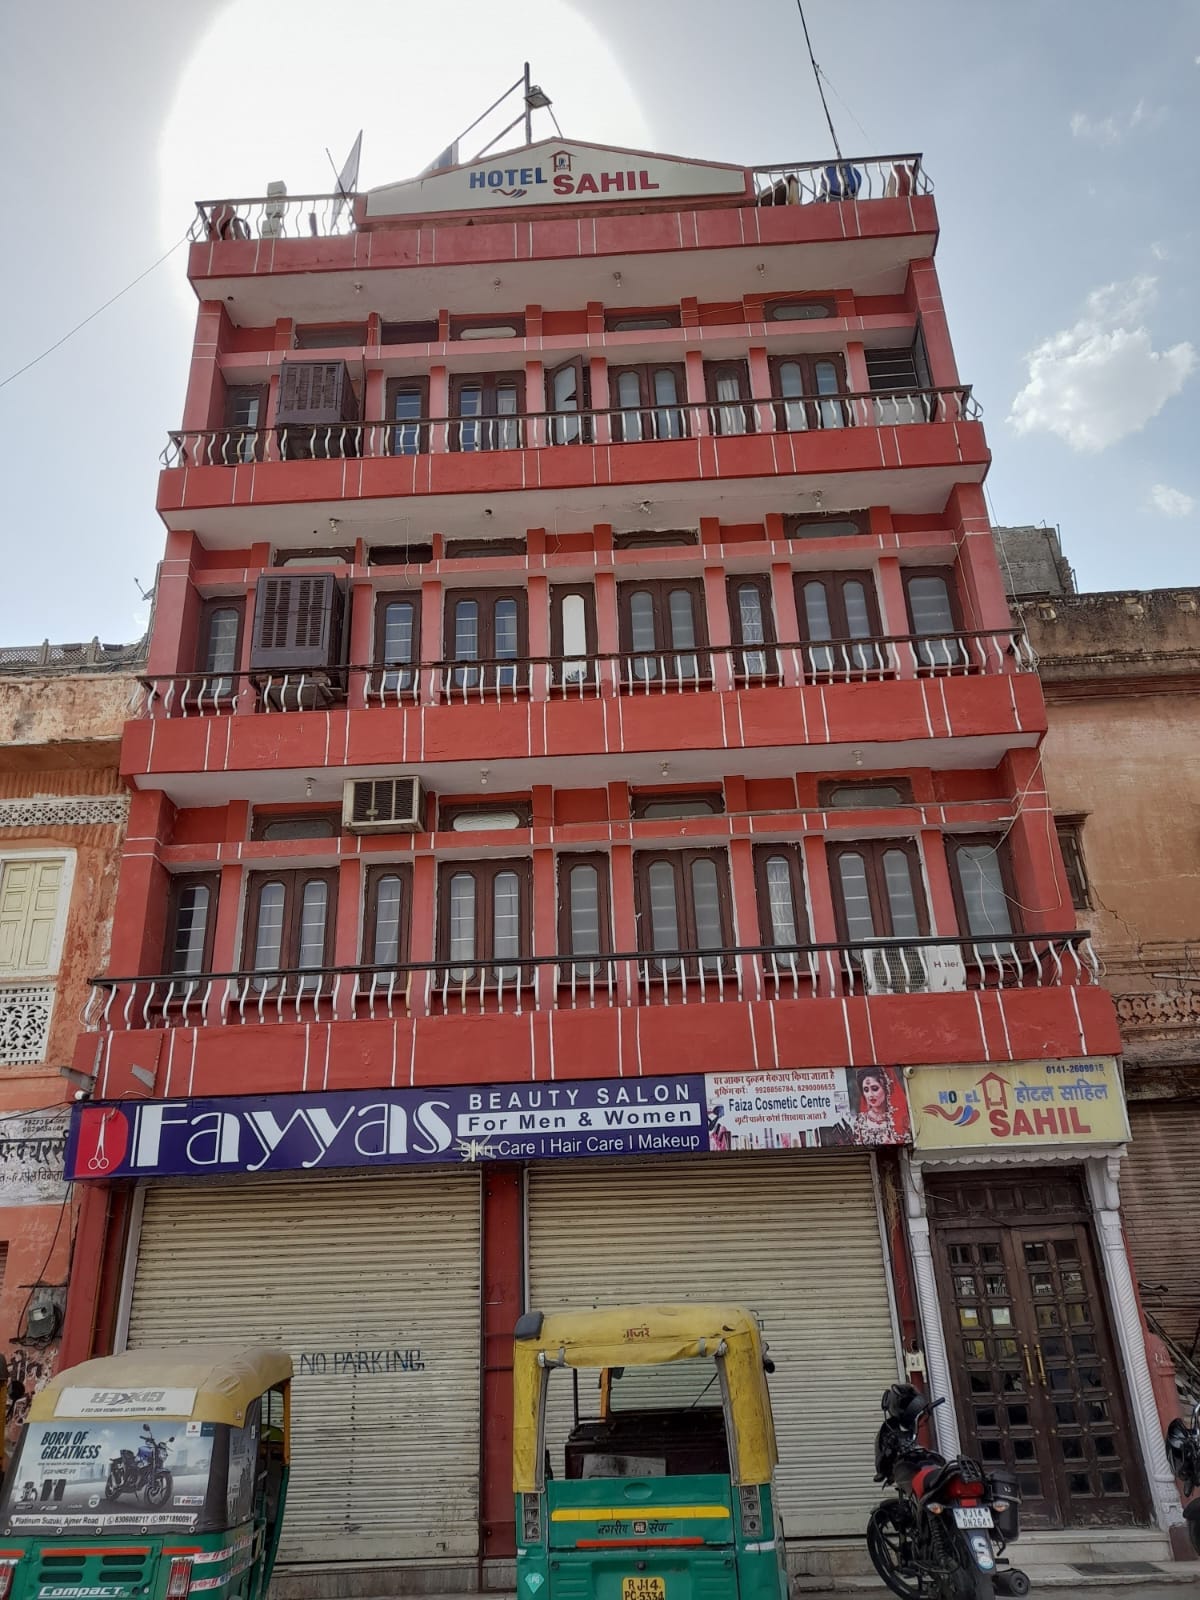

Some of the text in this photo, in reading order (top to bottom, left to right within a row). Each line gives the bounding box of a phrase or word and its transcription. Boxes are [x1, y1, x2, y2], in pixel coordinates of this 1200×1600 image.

[469, 167, 660, 195] HOTEL SAHIL
[469, 1084, 689, 1111] BEAUTY SALON
[1014, 1078, 1108, 1104] होटल साहिल
[729, 1094, 831, 1112] Faiza Cosmetic Centre
[469, 1109, 691, 1132] For Men & Women
[989, 1107, 1091, 1137] SAHIL
[130, 1100, 453, 1171] Fayyas
[499, 1141, 535, 1156] Care
[550, 1138, 581, 1154] Hair
[586, 1136, 623, 1152] Care
[639, 1133, 700, 1150] Makeup
[300, 1350, 425, 1375] NO PARKING
[41, 1431, 89, 1446] BORN OF
[41, 1445, 102, 1460] GREATNESS
[15, 1516, 41, 1525] Platinum
[83, 1516, 99, 1525] Road
[38, 1586, 125, 1598] Compact
